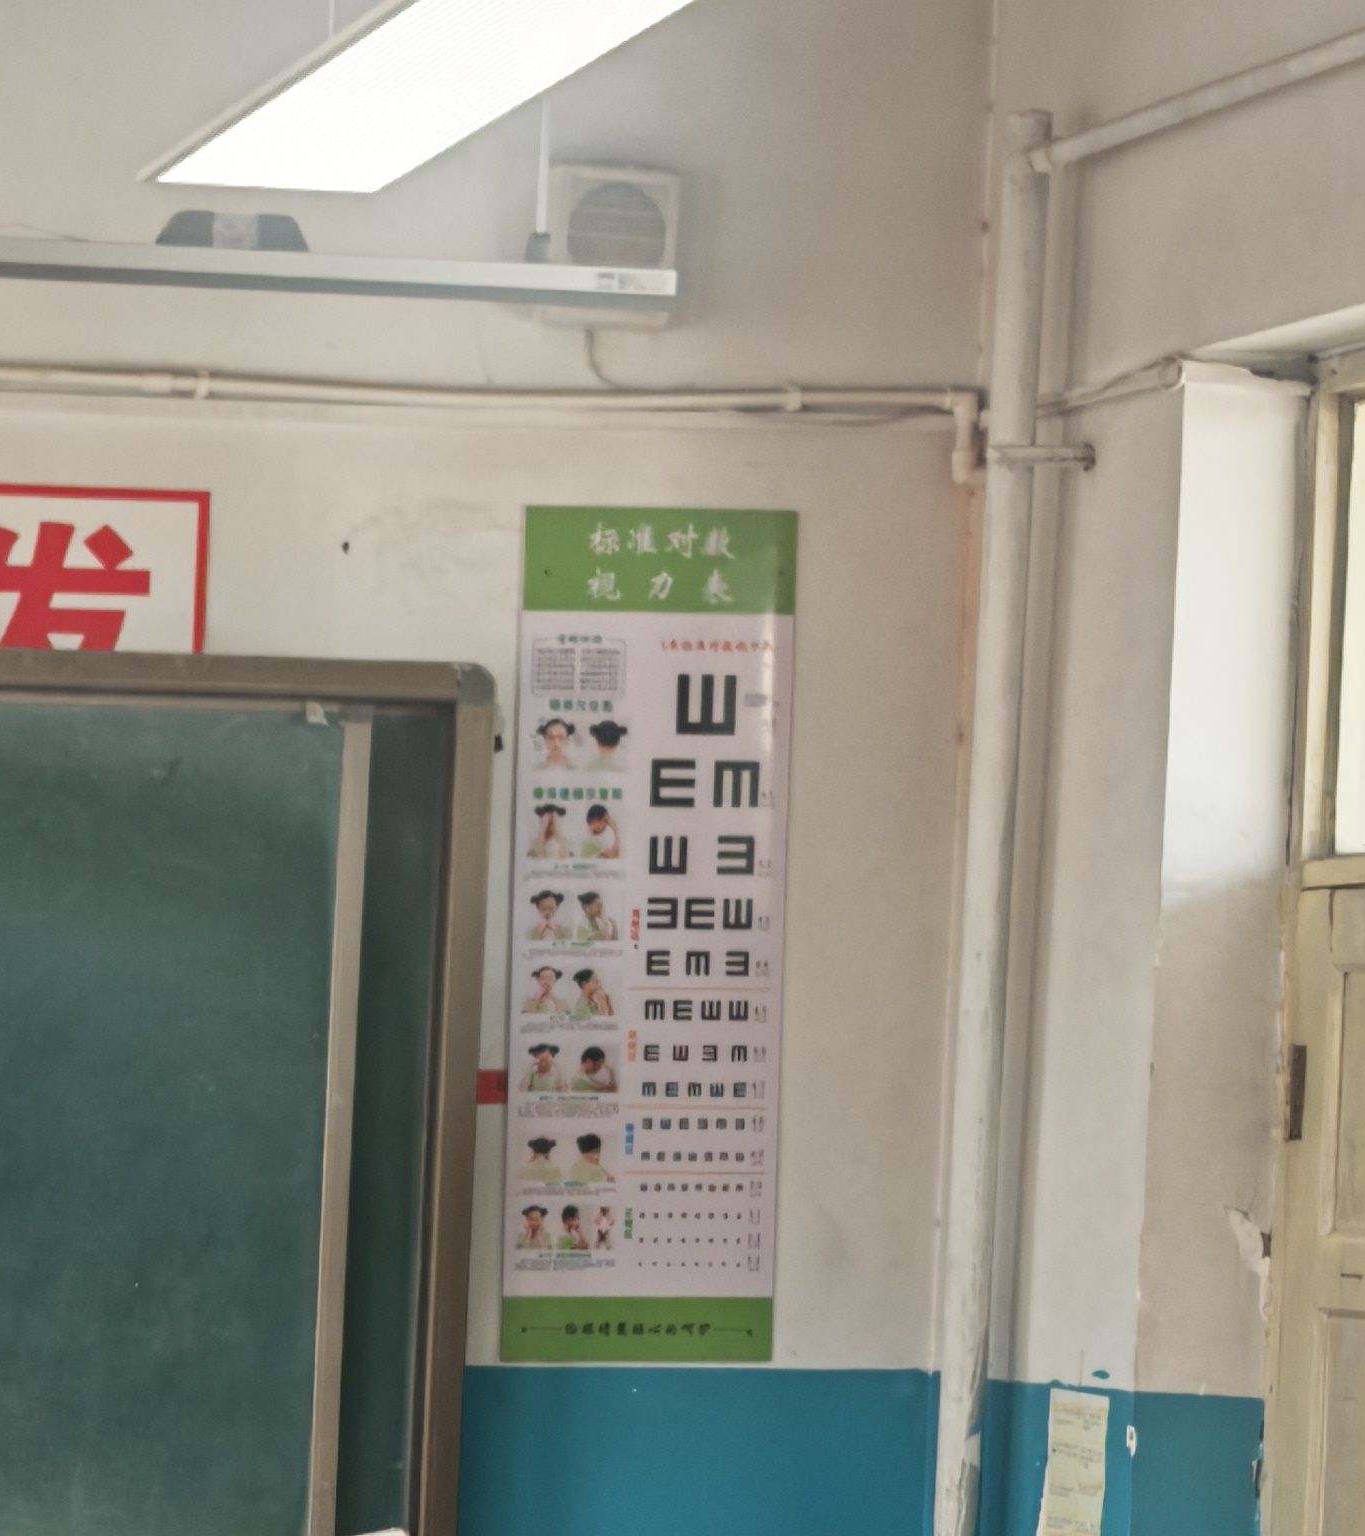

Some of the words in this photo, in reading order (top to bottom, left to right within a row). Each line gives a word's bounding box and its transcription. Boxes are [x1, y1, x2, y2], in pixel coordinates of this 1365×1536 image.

[589, 523, 736, 559] 标准对数
[588, 568, 734, 604] 视力表
